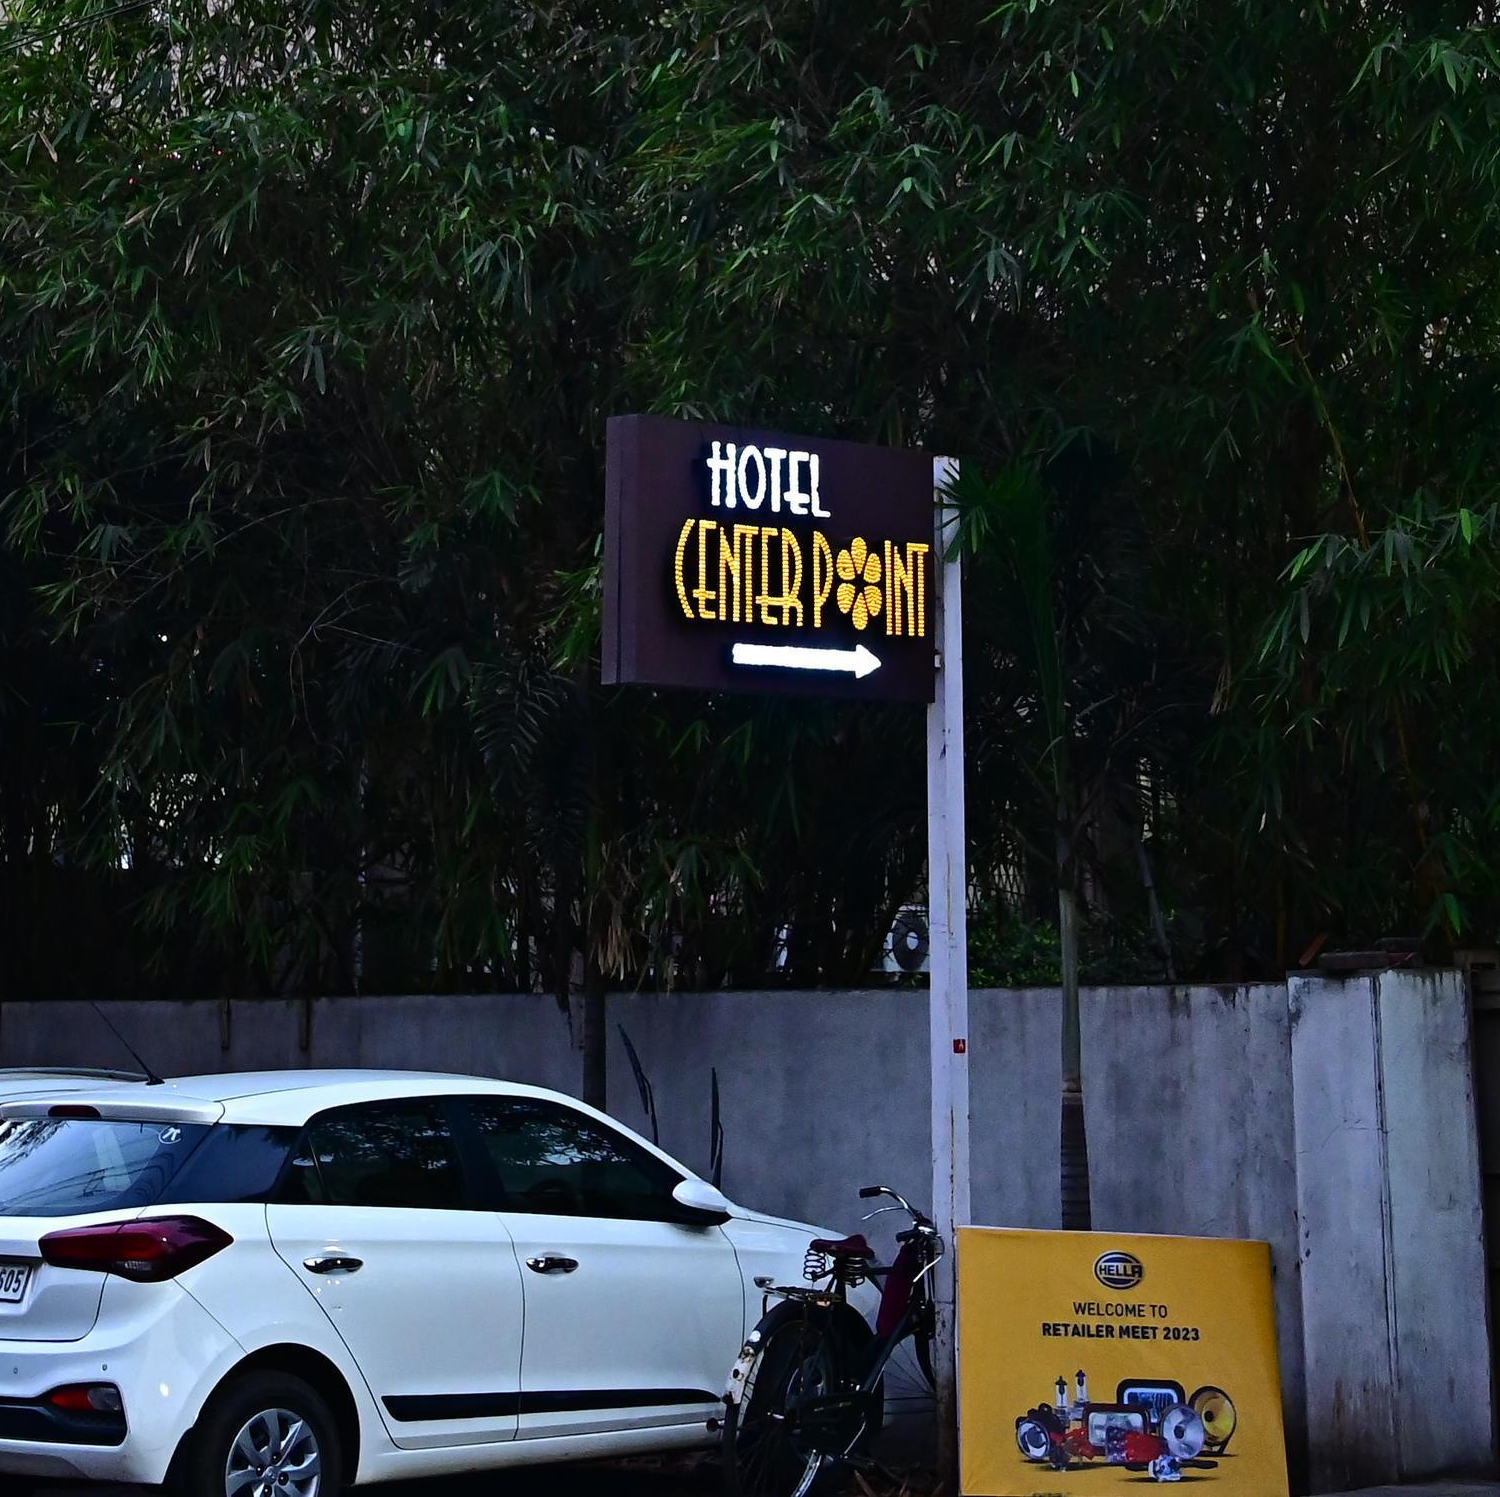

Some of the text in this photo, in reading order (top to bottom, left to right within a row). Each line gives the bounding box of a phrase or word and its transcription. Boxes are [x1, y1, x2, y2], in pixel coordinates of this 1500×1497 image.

[706, 441, 831, 518] HOTEL
[675, 518, 803, 627] CENTER
[1099, 1264, 1143, 1278] HELLA
[1073, 1301, 1168, 1318] WELCOME TO
[1042, 1323, 1200, 1341] RETAILER MEET 2023
